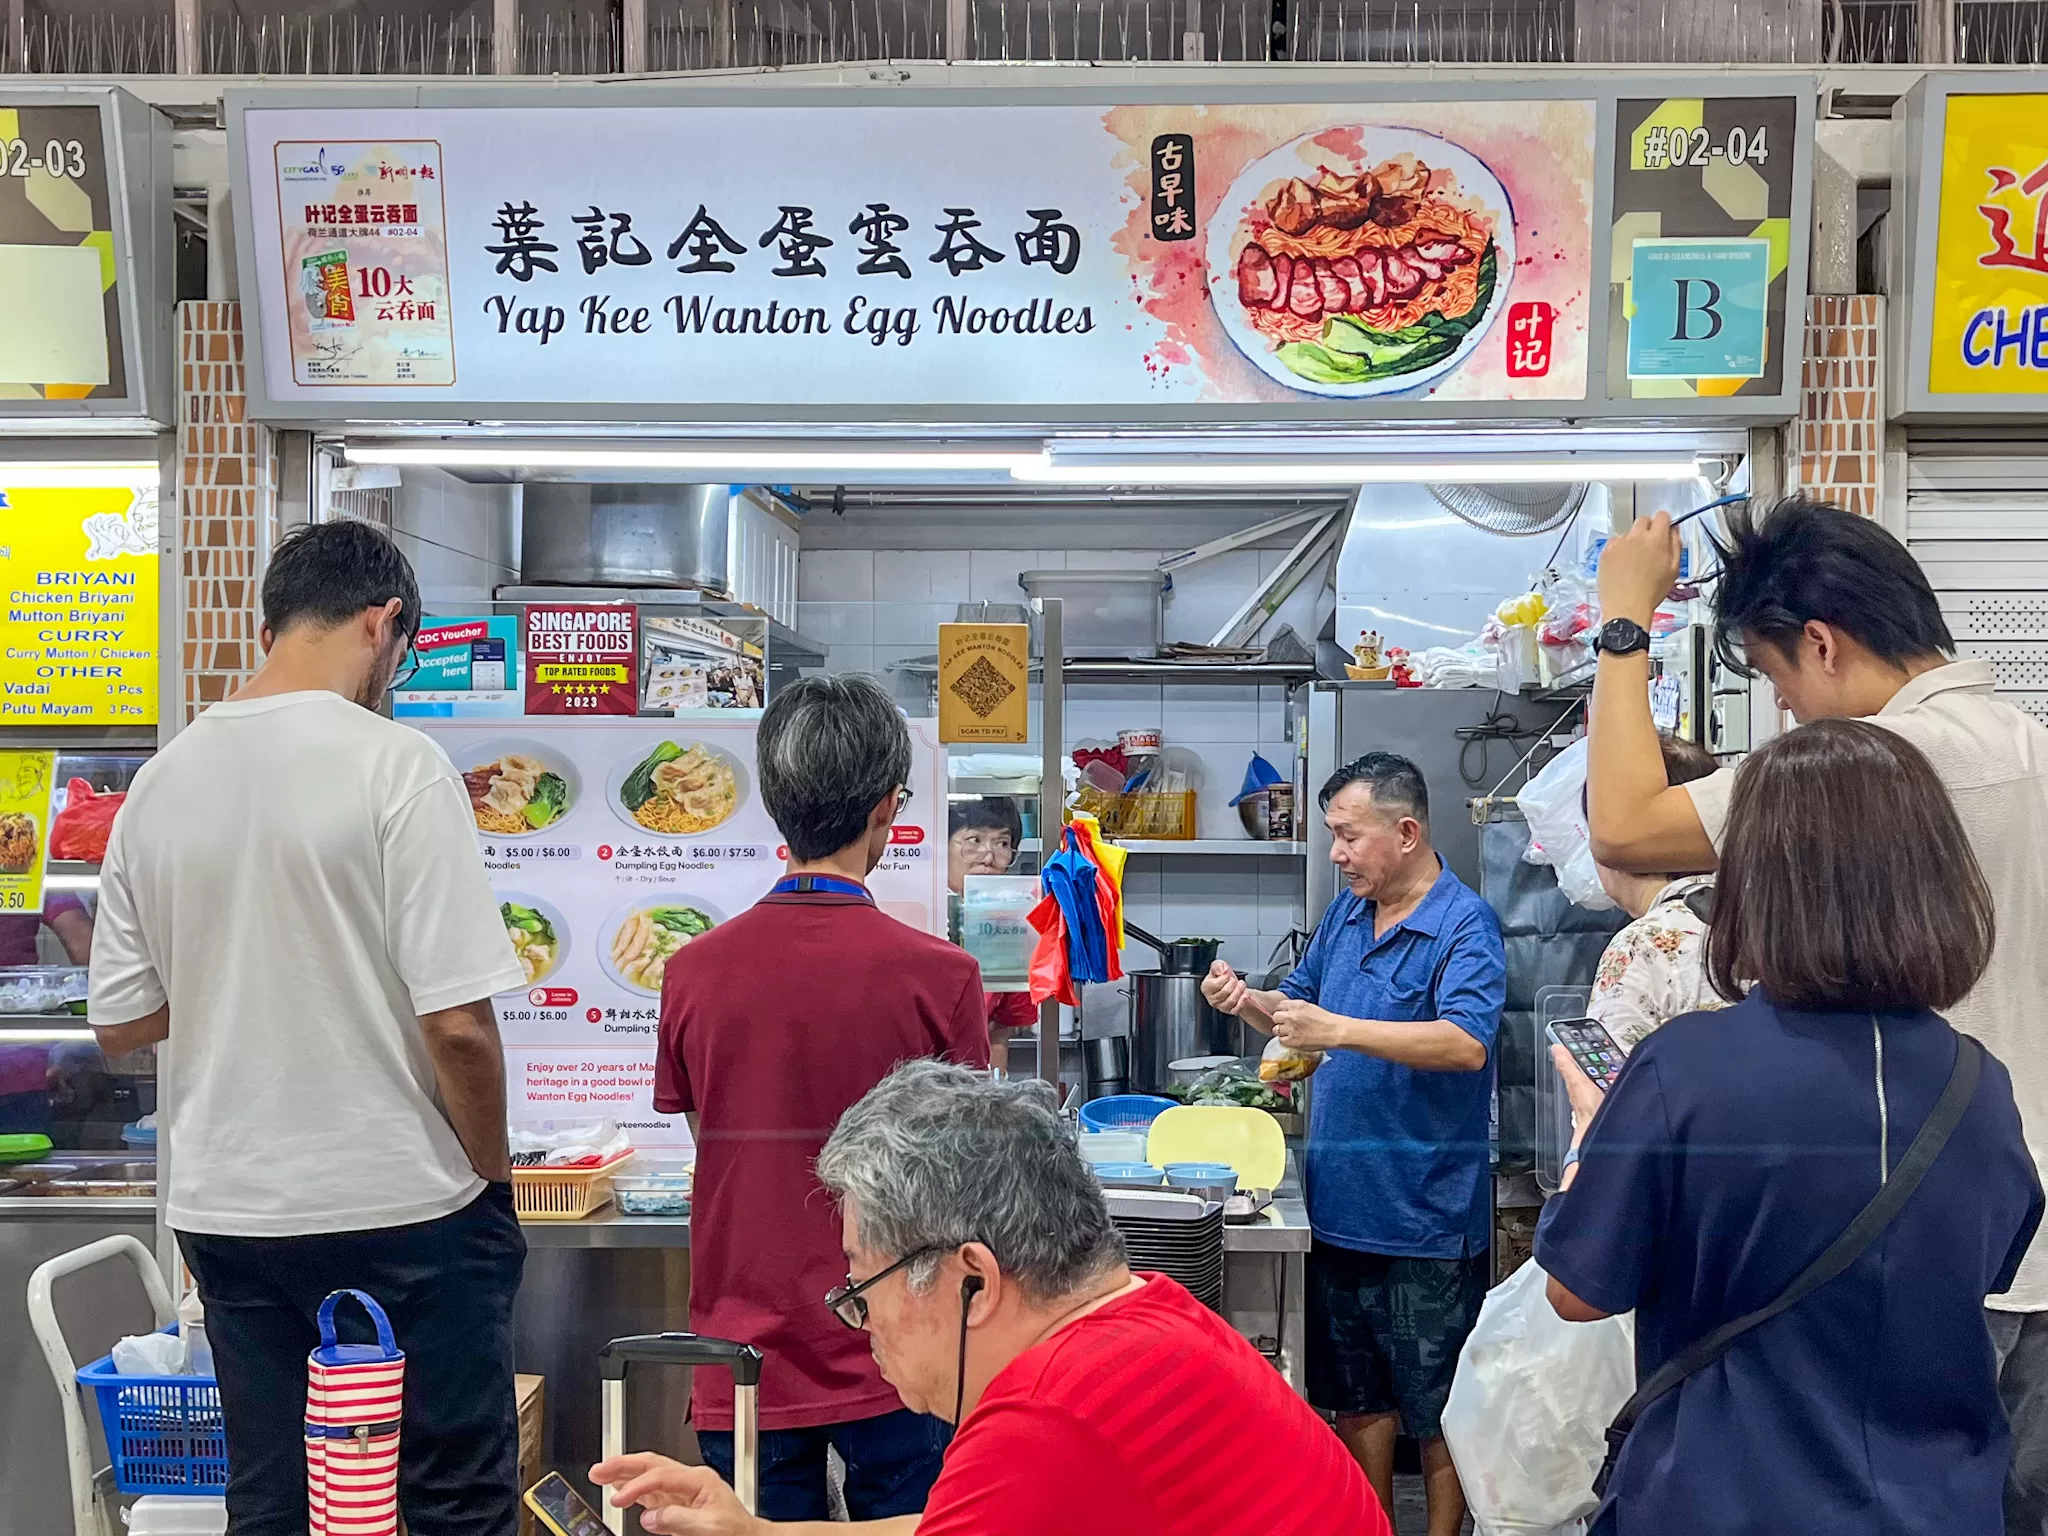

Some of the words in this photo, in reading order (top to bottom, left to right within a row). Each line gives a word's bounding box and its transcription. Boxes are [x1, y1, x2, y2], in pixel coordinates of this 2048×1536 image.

[1643, 126, 1769, 168] #02-04
[1154, 140, 1192, 235] 古早味
[305, 204, 418, 224] 叶记全蛋云吞面
[388, 228, 418, 236] #02-04
[483, 200, 1081, 282] 葉記全蛋雲吞面
[325, 266, 351, 317] 美食
[374, 300, 436, 321] 云吞面
[1668, 279, 1723, 341] B
[482, 295, 565, 346] Yap
[579, 295, 652, 334] Kee
[663, 295, 832, 334] Wanton
[843, 295, 921, 346] Egg
[932, 295, 1097, 334] Noodles
[1511, 315, 1548, 372] 叶记
[36, 572, 135, 585] BRIYANI
[10, 591, 73, 604] Chicken
[79, 591, 134, 606] Briyani
[8, 610, 63, 622] Mutton
[69, 610, 125, 625] Briyani
[529, 611, 632, 631] SINGAPORE
[38, 630, 125, 642] CURRY
[417, 633, 439, 644] CDC
[441, 627, 482, 641] Voucher
[532, 633, 571, 649] BEST
[577, 633, 628, 649] FOODS
[6, 648, 40, 661] Curry
[46, 648, 88, 659] Mutton
[100, 647, 150, 659] Chicken
[559, 653, 602, 663] ENJOY
[36, 666, 122, 677] OTHER
[442, 666, 468, 677] here
[544, 667, 559, 676] TOP
[562, 667, 587, 676] RATED
[590, 667, 616, 676] FOODS
[4, 682, 51, 694] Vadai
[106, 685, 114, 694] 3
[118, 685, 143, 694] Pcs
[565, 697, 598, 707] 2023
[2, 703, 36, 714] Putu
[41, 703, 94, 717] Mayam
[110, 705, 116, 714] 3
[120, 705, 143, 714] Pcs
[506, 847, 533, 857] $5.00
[542, 847, 570, 857] $6.00
[601, 848, 608, 857] 2
[693, 847, 720, 858] $6.00
[729, 847, 755, 858] $7.50
[893, 847, 920, 857] $6.00
[484, 861, 520, 870] Noodles
[615, 861, 657, 871] Dumpling
[659, 861, 676, 871] Egg
[678, 861, 714, 870] Noodles
[893, 862, 910, 870] Fun
[503, 1011, 530, 1021] $5.00
[540, 1011, 567, 1021] $6.00
[591, 1011, 597, 1020] 5
[604, 1024, 650, 1034] Dumpling
[526, 1063, 554, 1072] Enjoy
[556, 1064, 578, 1072] over
[580, 1063, 595, 1072] 20
[597, 1064, 625, 1073] years
[627, 1062, 637, 1072] of
[526, 1077, 568, 1087] heritage
[570, 1077, 580, 1086] in
[590, 1077, 616, 1087] good
[618, 1077, 643, 1086] bowl
[526, 1092, 566, 1101] Wanton
[568, 1092, 587, 1102] Egg
[589, 1092, 635, 1101] Noodles!
